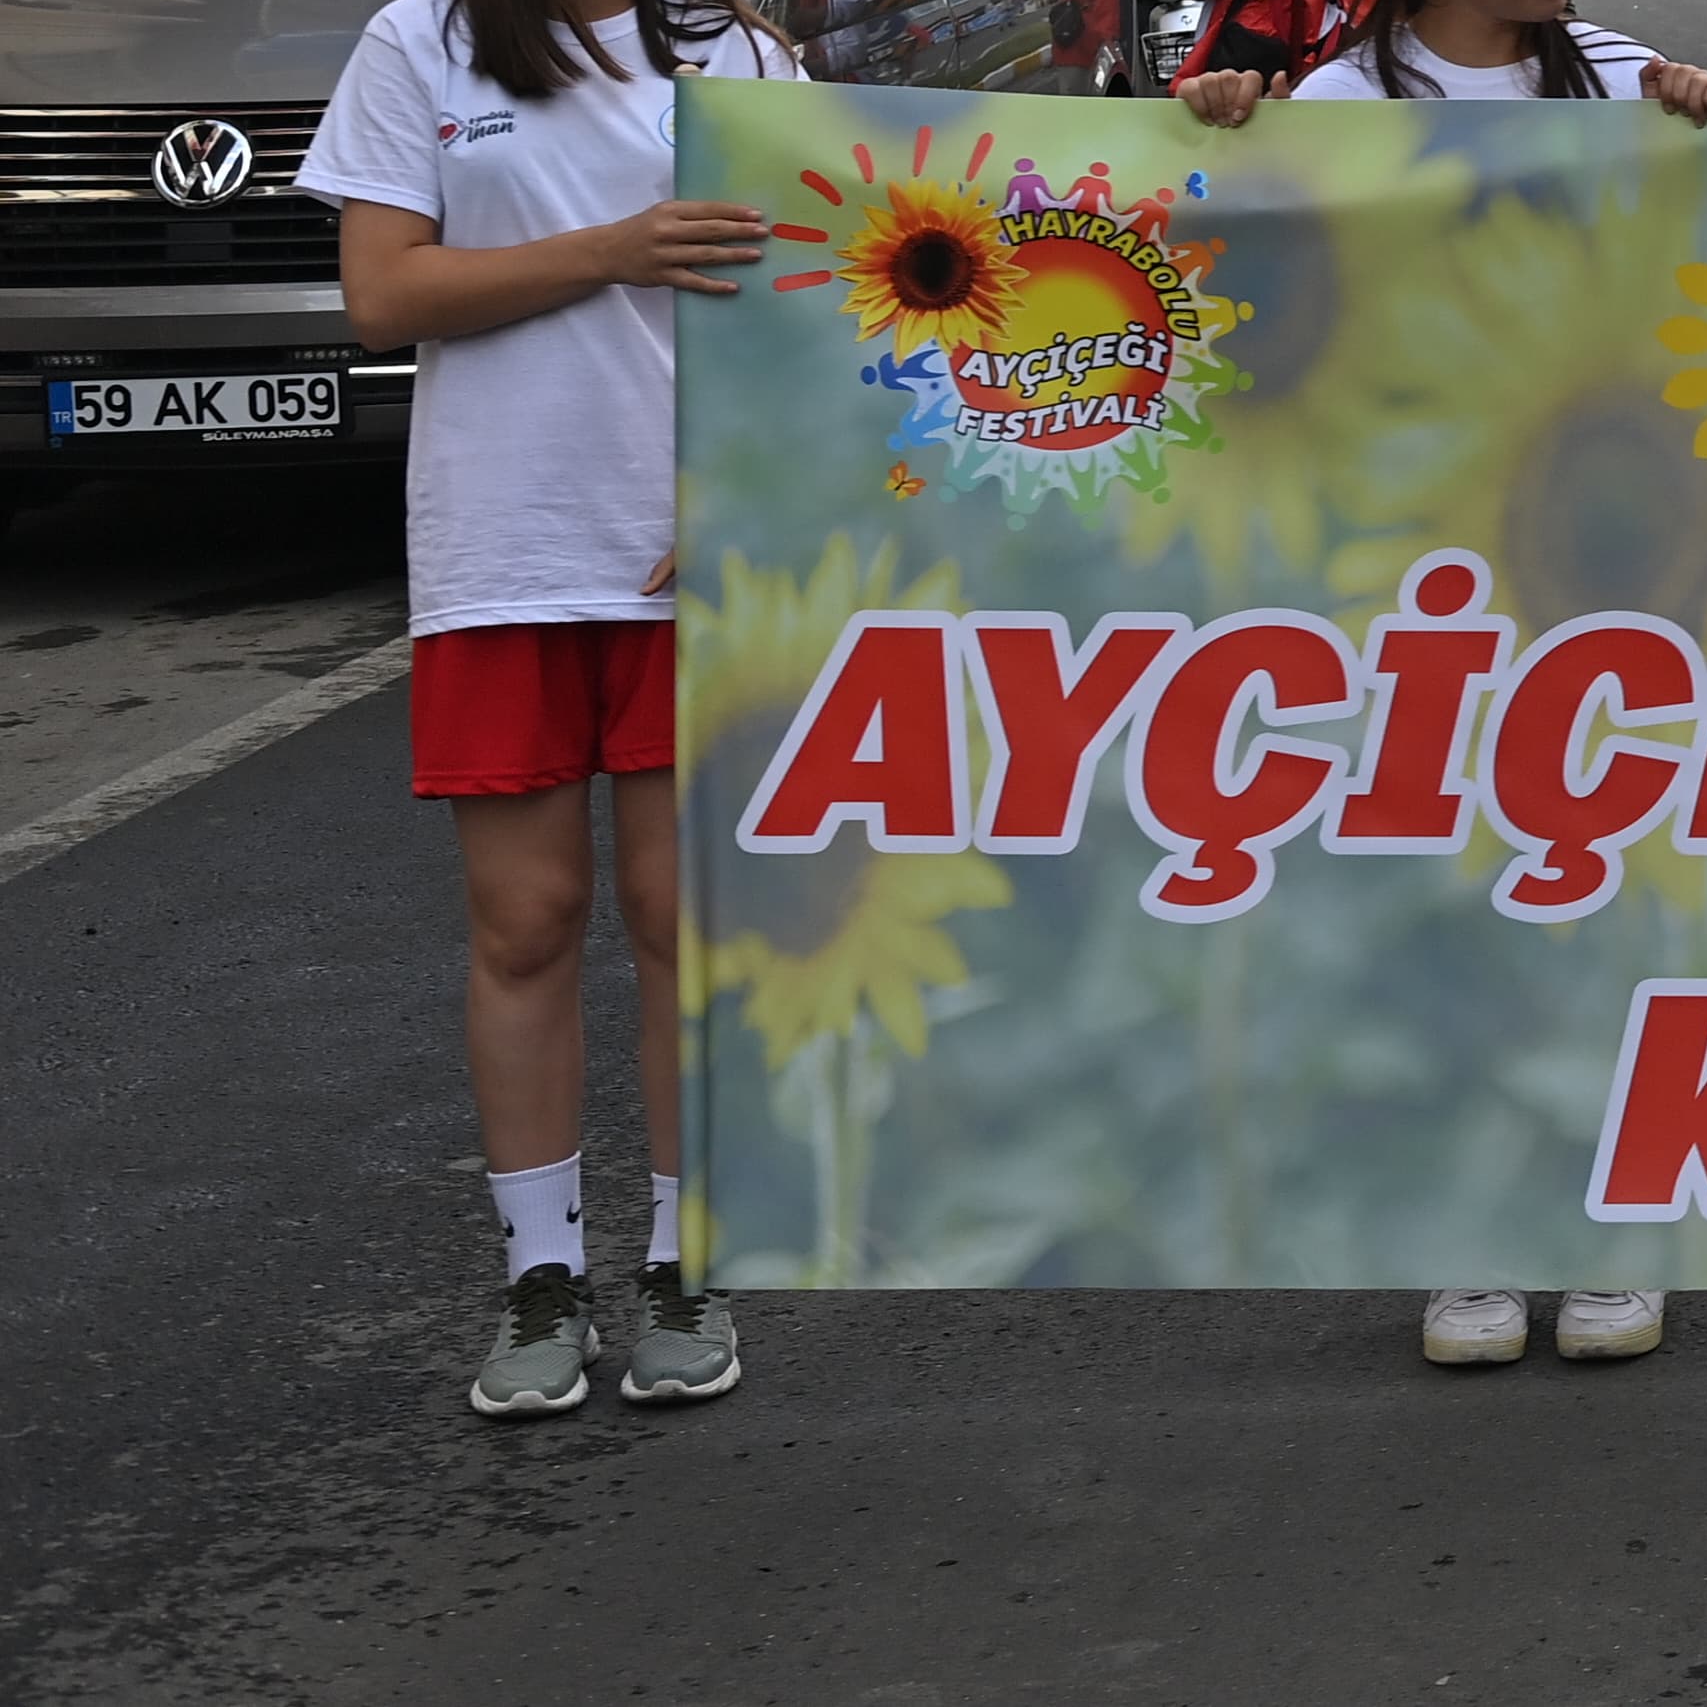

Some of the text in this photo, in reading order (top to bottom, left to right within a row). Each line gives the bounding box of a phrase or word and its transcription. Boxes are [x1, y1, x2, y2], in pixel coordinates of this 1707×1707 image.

[1002, 208, 1201, 341] HAYRABOLU
[958, 321, 1169, 398] AYÇİÇEĞİ
[52, 410, 73, 425] TR
[74, 376, 337, 429] 59 AK 059
[955, 392, 1167, 443] FESTİVALİ
[201, 427, 335, 443] SÜLEYMANPAŞA
